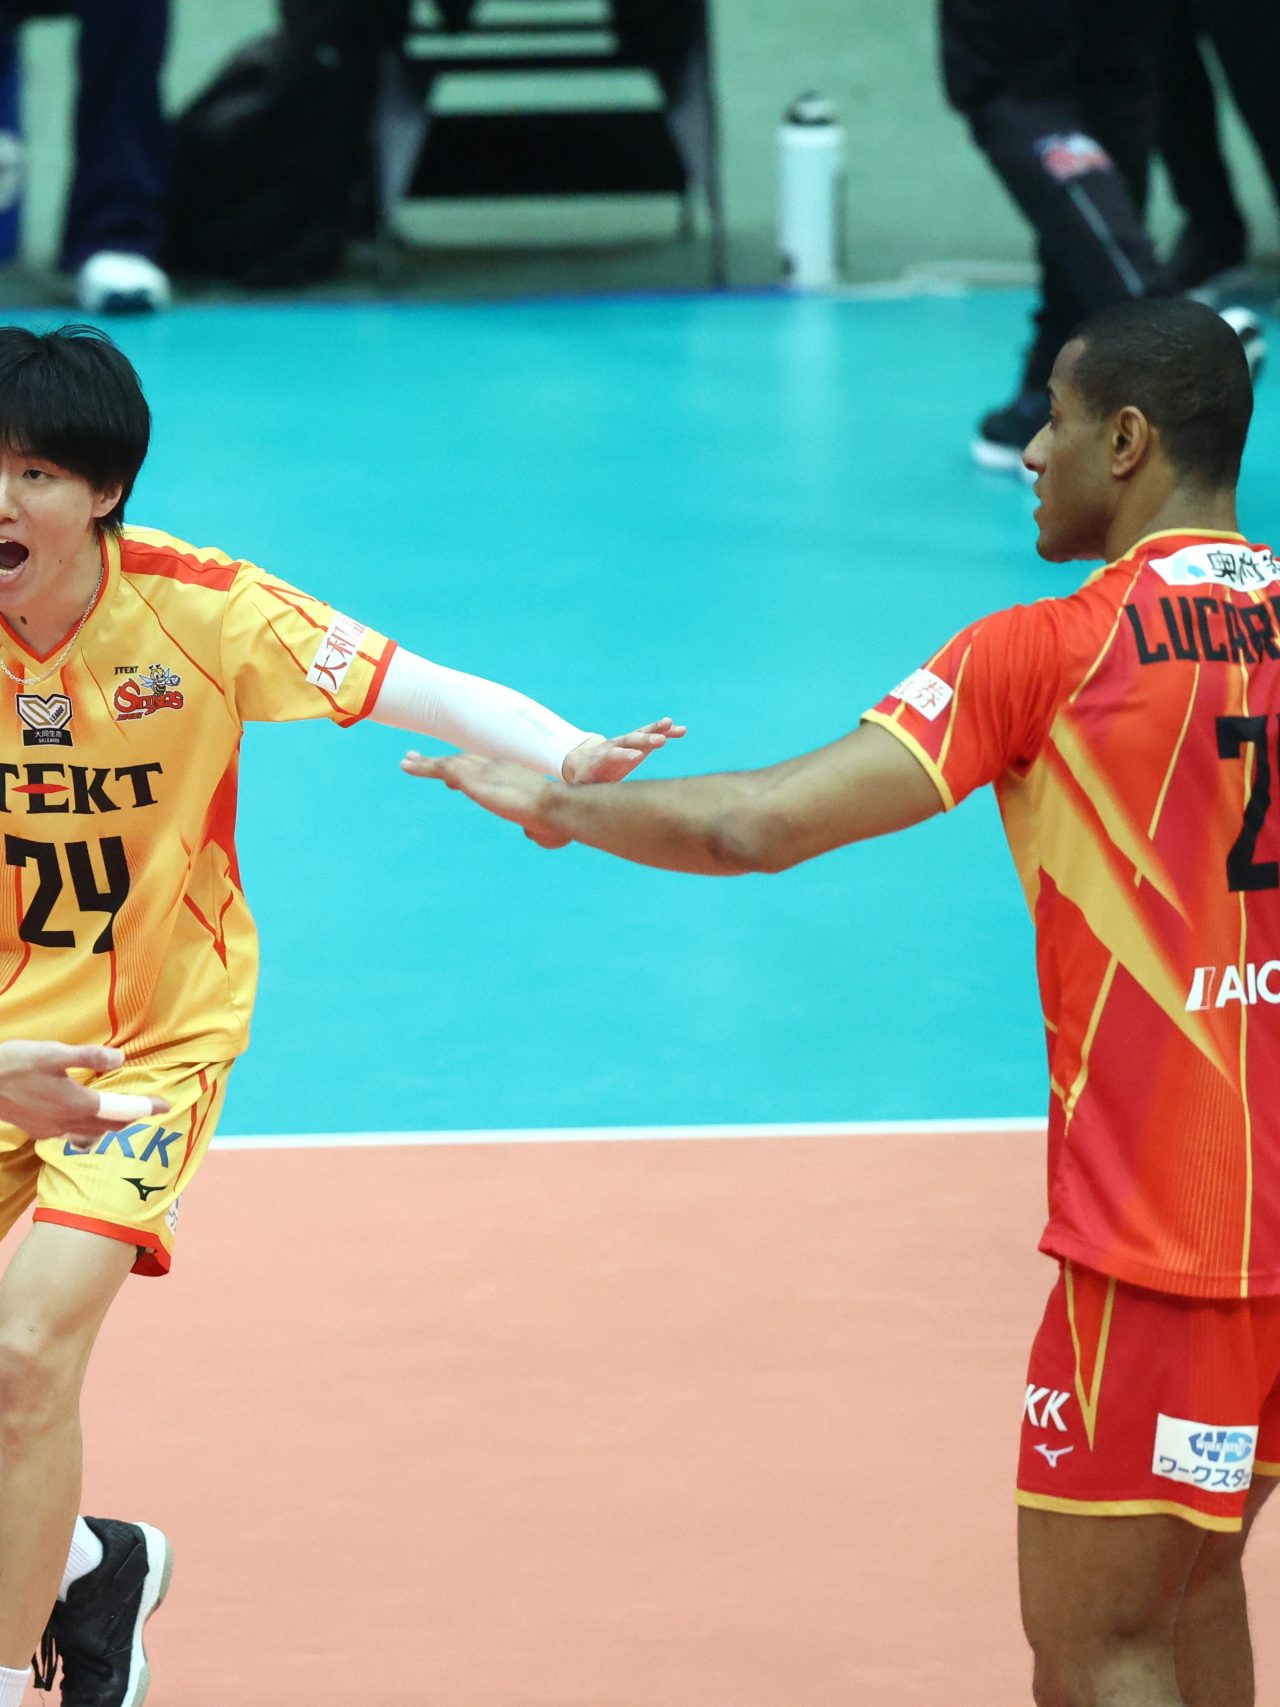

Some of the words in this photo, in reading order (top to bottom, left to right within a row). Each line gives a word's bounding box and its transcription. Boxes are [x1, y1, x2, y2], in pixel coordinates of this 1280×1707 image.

[1125, 595, 1280, 665] LUCAR
[1214, 715, 1280, 893] 2
[4, 833, 130, 955] 24
